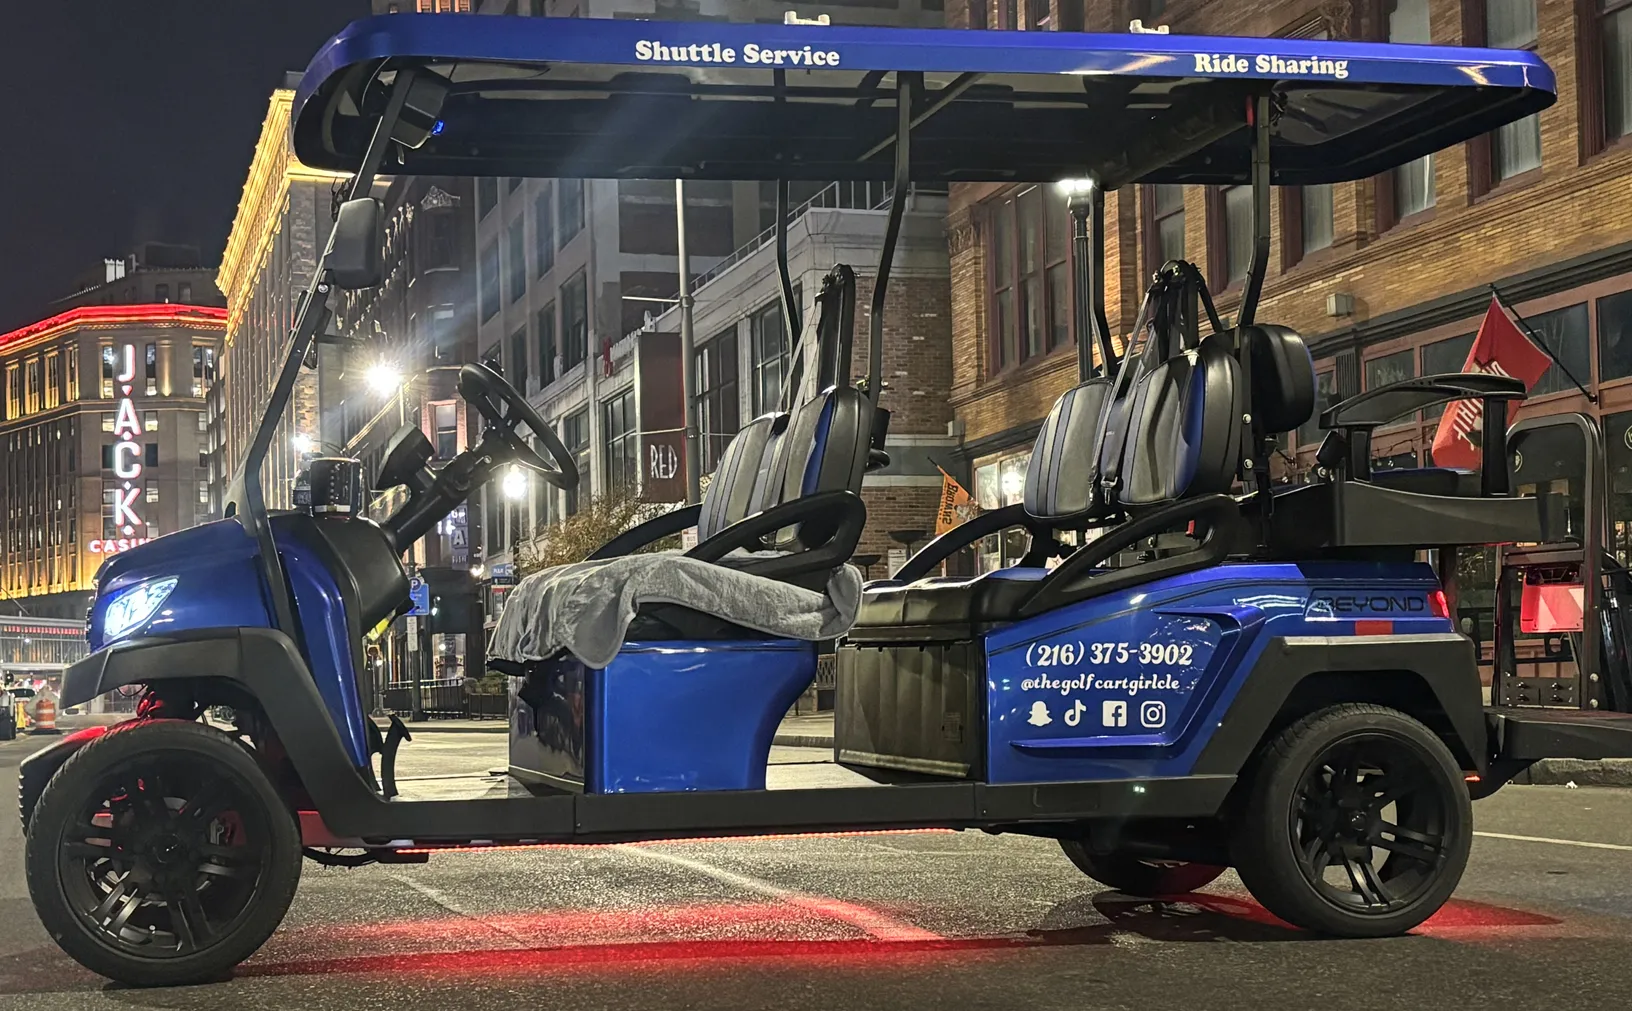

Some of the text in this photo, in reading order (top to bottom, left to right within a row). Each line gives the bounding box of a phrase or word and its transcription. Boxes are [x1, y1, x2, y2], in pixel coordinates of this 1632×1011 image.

[635, 40, 840, 66] Shuttle Service
[1194, 53, 1349, 79] Ride Sharing
[650, 444, 678, 479] RED
[1317, 597, 1424, 611] BEYOND
[1025, 641, 1193, 667] (216) 375-3902
